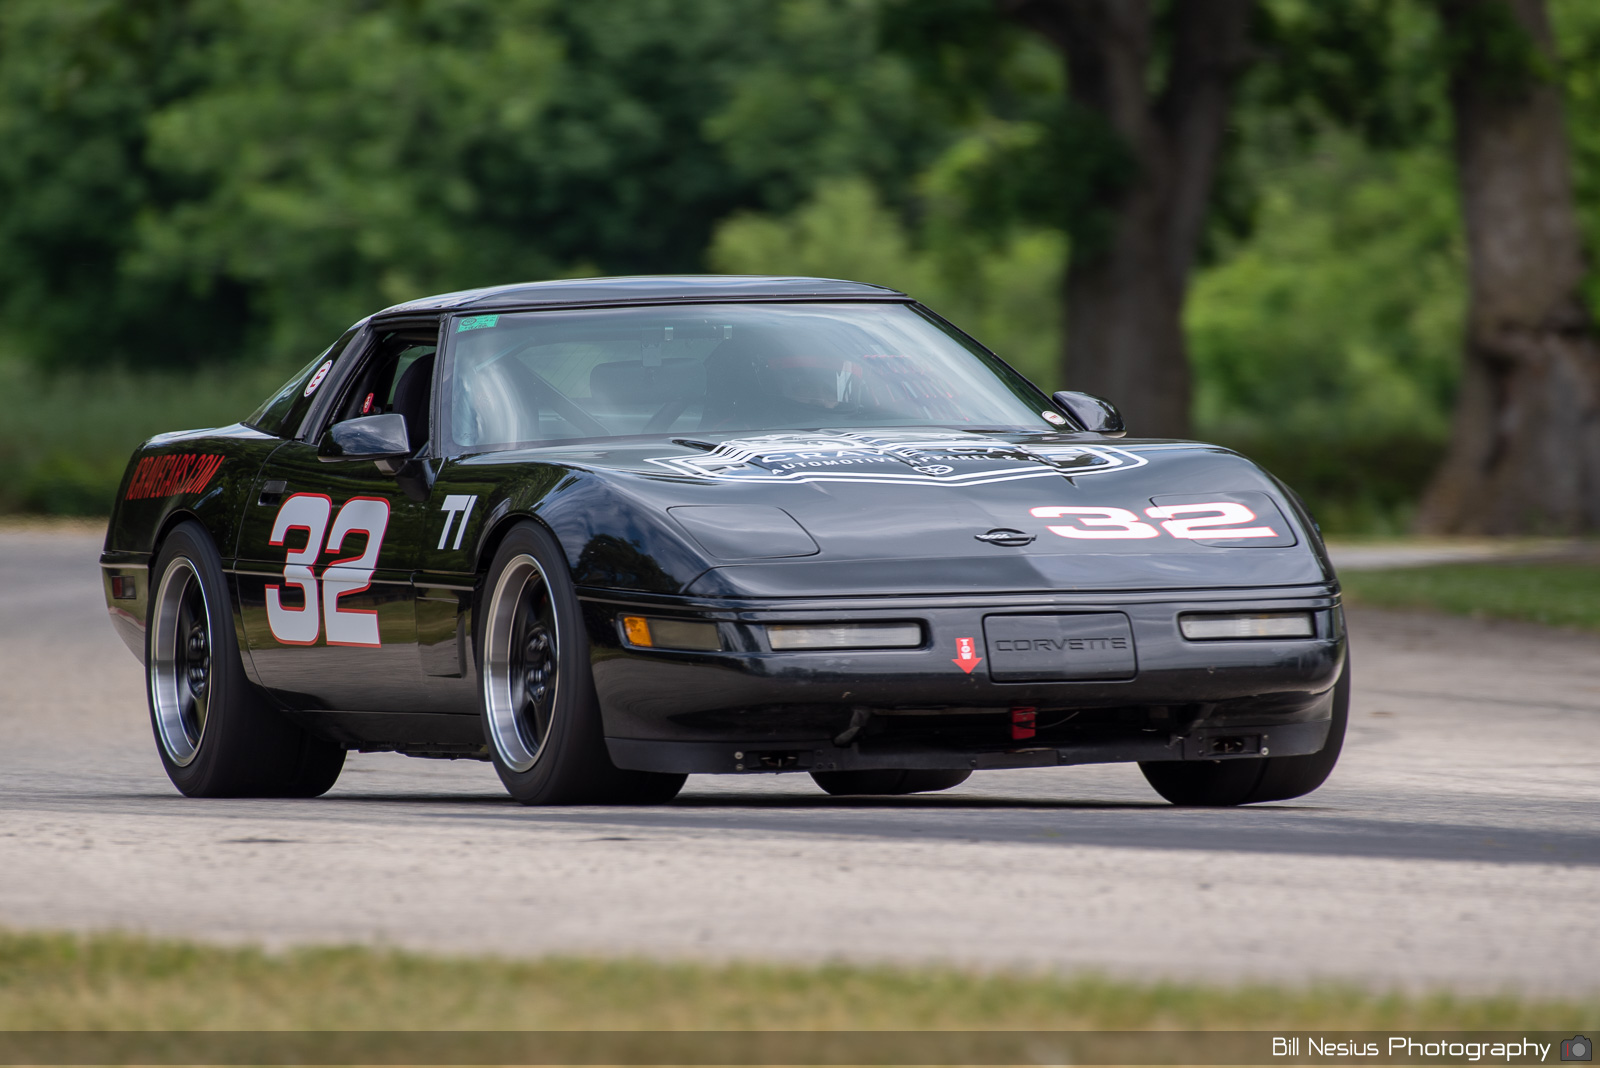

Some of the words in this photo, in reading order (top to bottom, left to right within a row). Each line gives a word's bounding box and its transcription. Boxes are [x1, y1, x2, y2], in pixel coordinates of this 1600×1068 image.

[771, 457, 902, 475] AUTOMOTIVE
[909, 454, 993, 466] APPAREL
[1029, 502, 1279, 540] 32
[265, 492, 391, 648] 32
[960, 638, 973, 660] TOW
[995, 638, 1127, 651] CORVETTE
